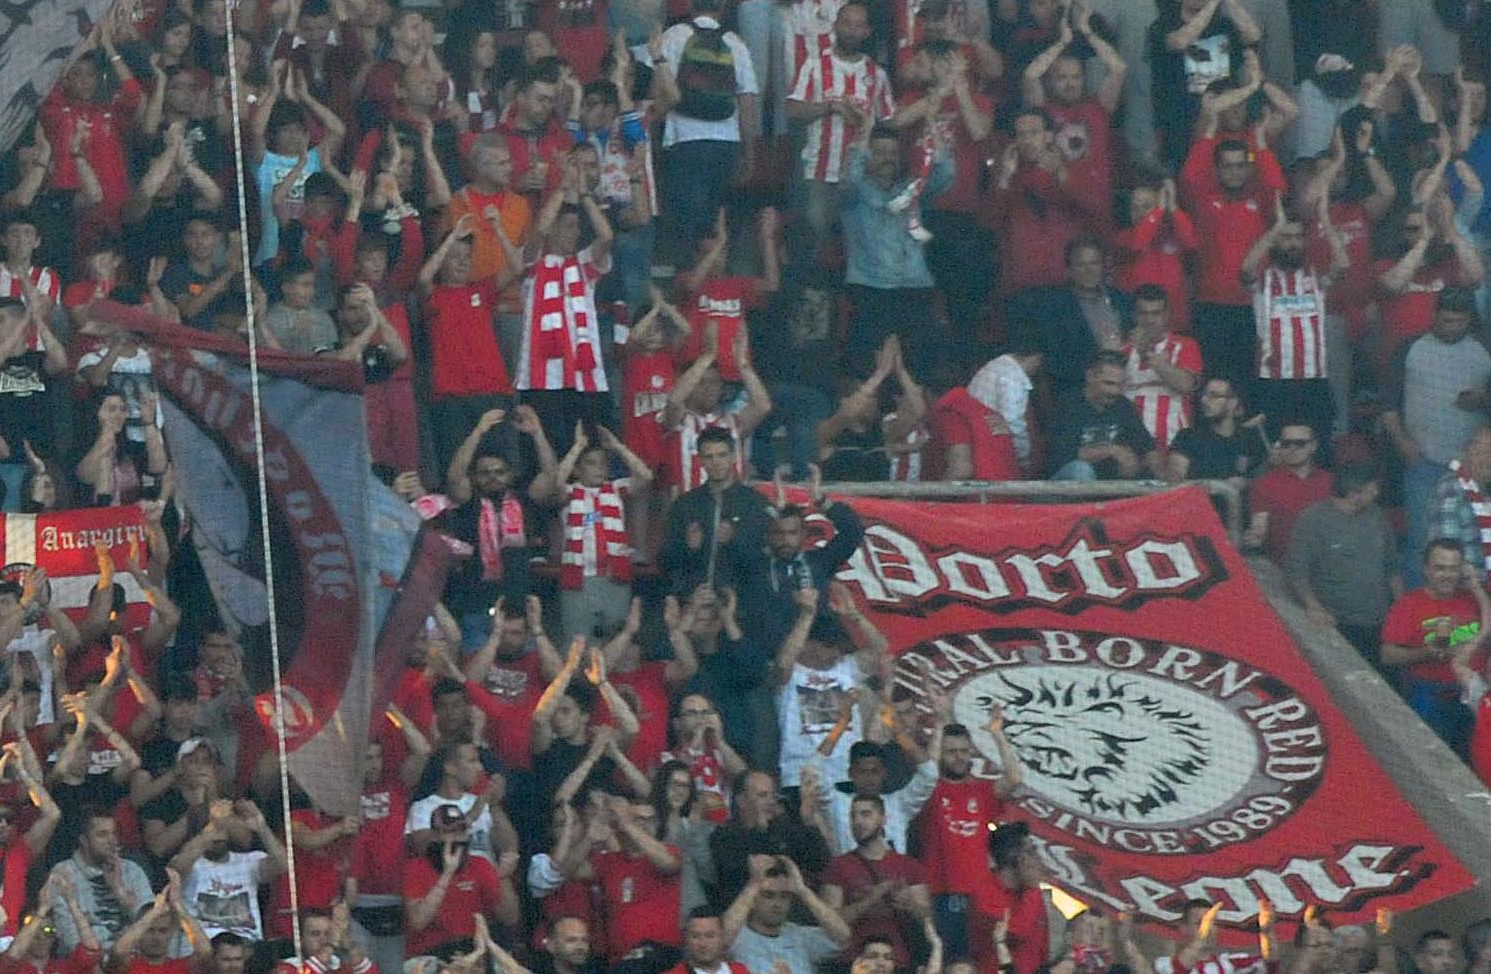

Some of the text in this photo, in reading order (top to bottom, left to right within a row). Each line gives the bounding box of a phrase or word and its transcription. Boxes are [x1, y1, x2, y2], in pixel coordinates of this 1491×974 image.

[836, 525, 1201, 603] Porto
[1041, 630, 1262, 698] BORN
[1245, 697, 1322, 784] RED
[1020, 793, 1293, 855] SINCE 1989
